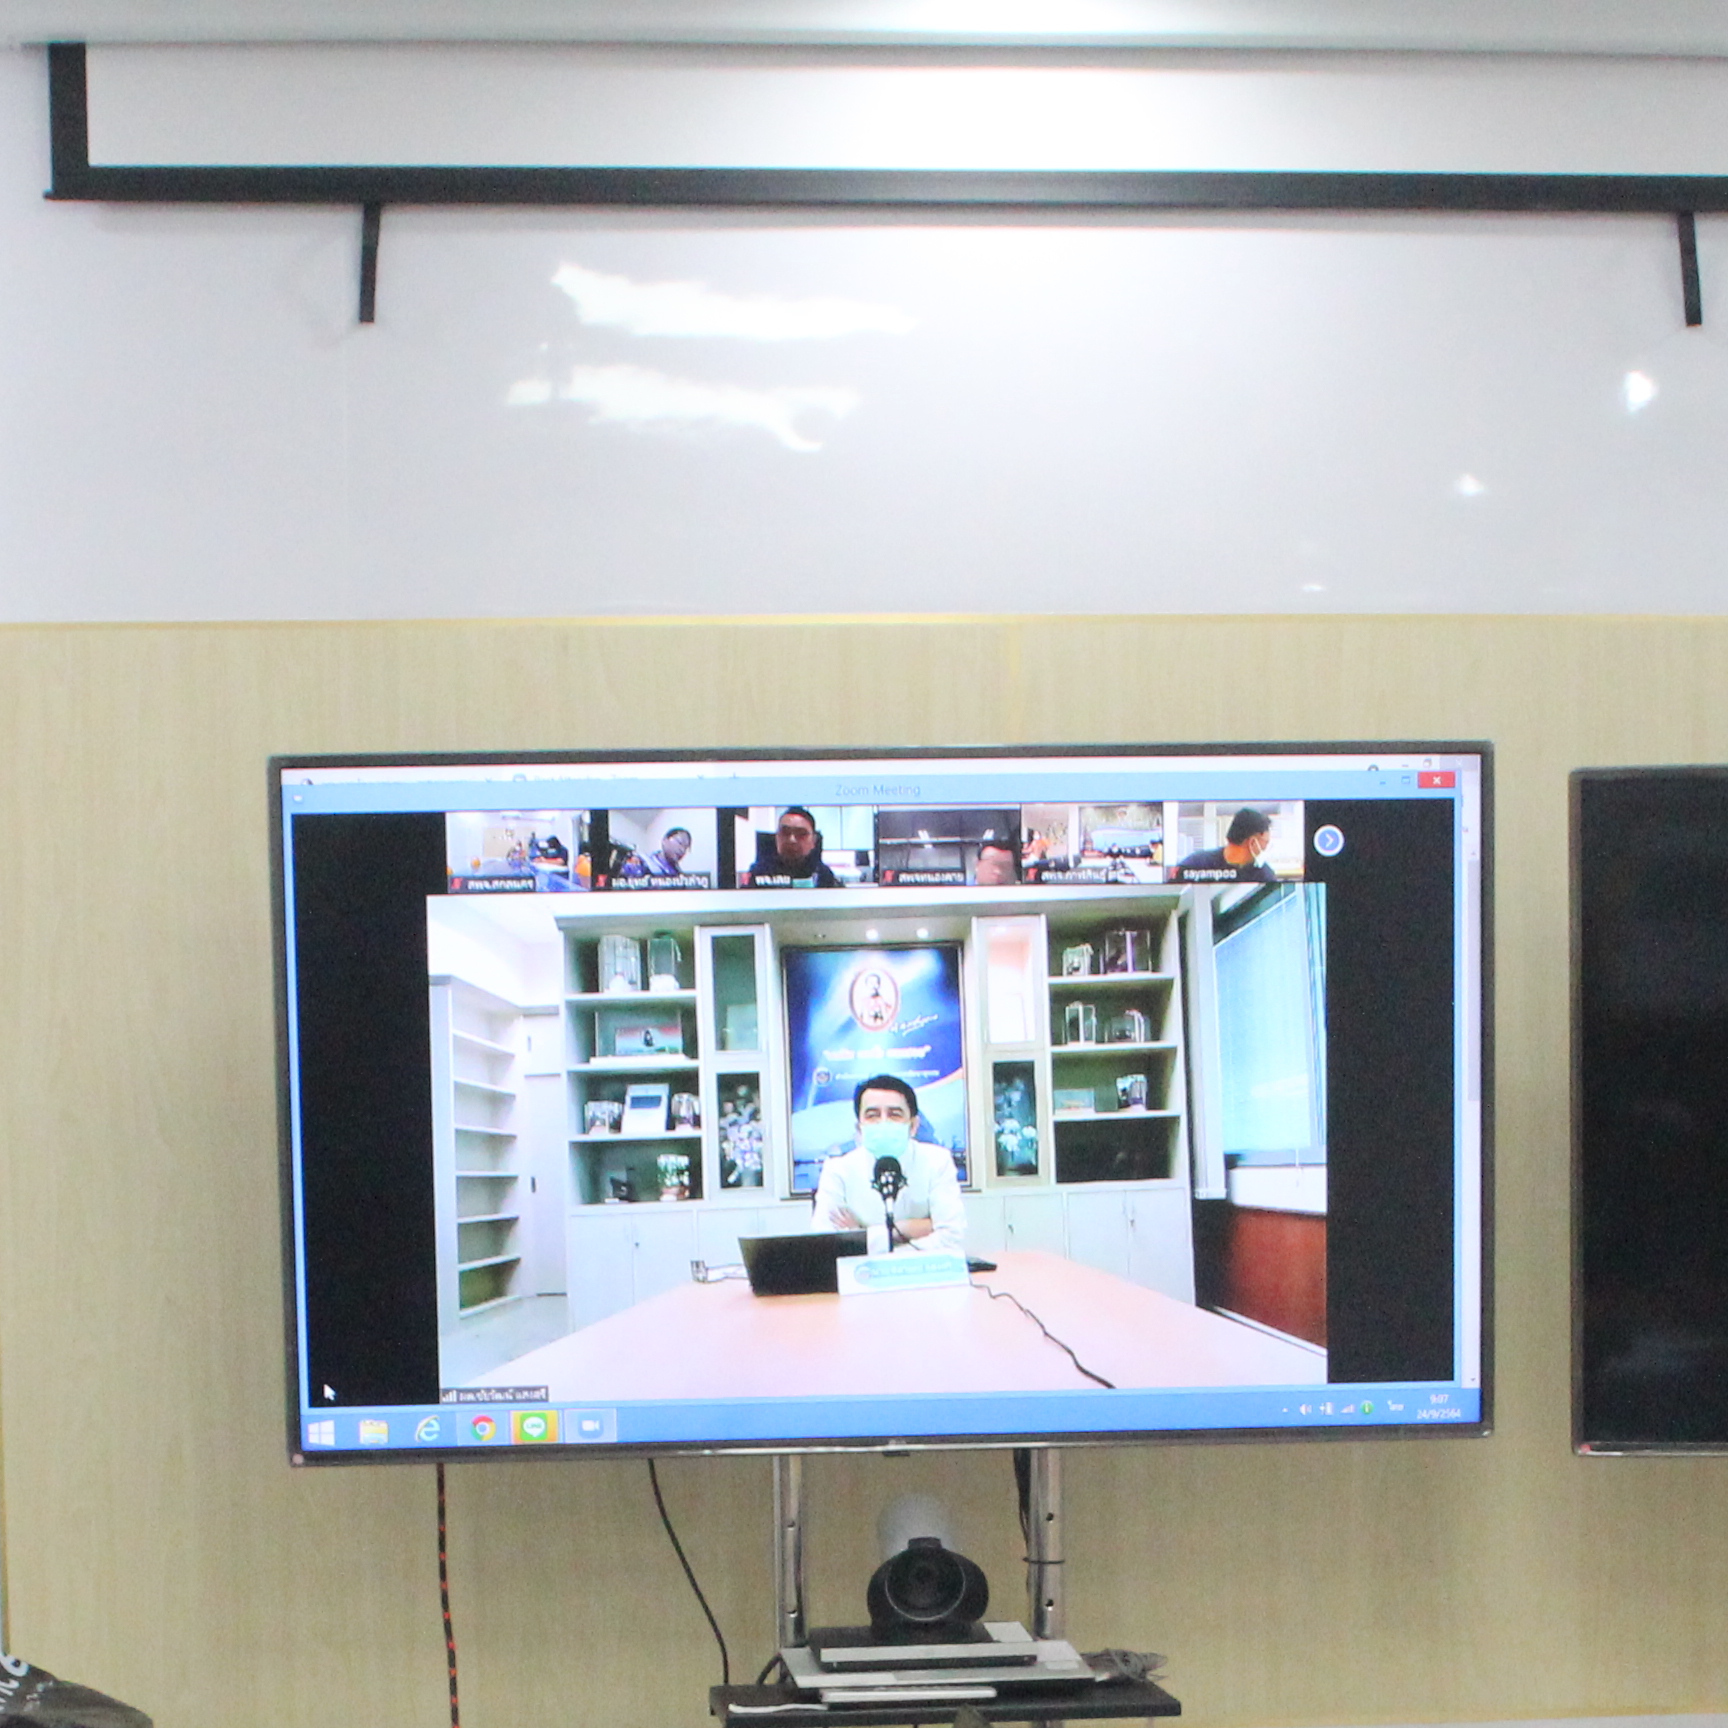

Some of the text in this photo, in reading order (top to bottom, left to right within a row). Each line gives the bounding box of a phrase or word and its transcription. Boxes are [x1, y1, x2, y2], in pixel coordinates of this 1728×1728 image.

[835, 784, 921, 797] Zoom Meeting
[1183, 868, 1238, 882] sayampoo
